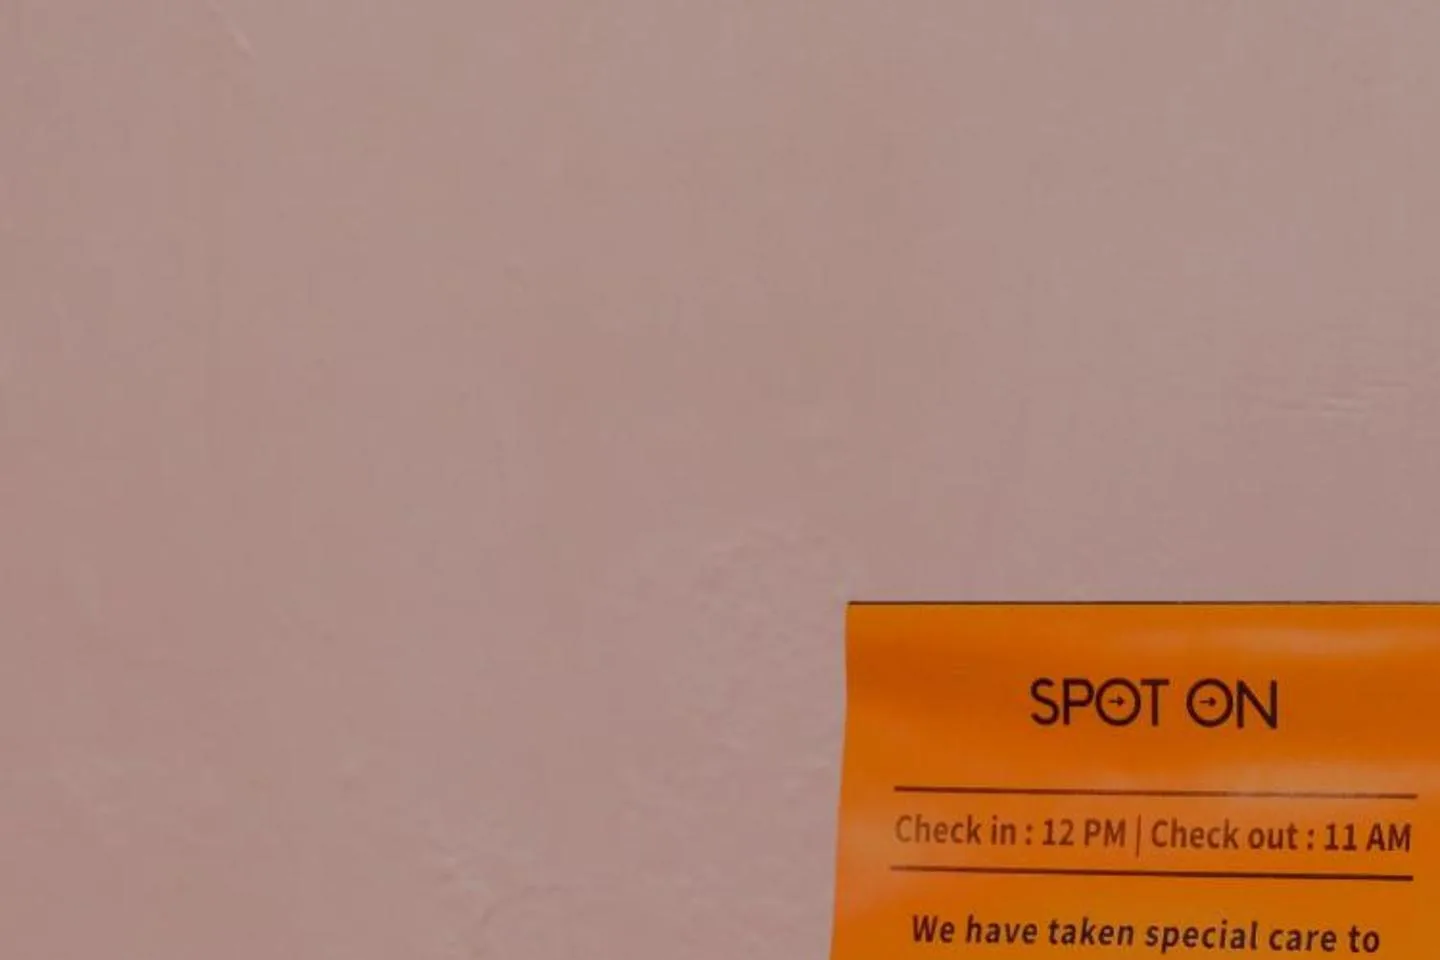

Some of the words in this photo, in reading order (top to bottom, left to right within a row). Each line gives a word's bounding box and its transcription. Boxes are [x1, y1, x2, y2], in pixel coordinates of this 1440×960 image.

[1027, 675, 1171, 731] SPOT
[1184, 676, 1283, 731] ON
[894, 814, 982, 845] Check
[989, 814, 1017, 845] in
[1042, 818, 1075, 847] 12
[1084, 818, 1126, 848] PM
[1151, 817, 1240, 850] Check
[1247, 822, 1299, 851] out
[1323, 821, 1358, 852] 11
[1365, 820, 1412, 854] AM
[912, 914, 957, 944] We
[964, 913, 1039, 946] have
[1047, 916, 1136, 950] taken
[1144, 918, 1260, 955] special
[1268, 928, 1340, 953] care
[1347, 924, 1381, 953] to
